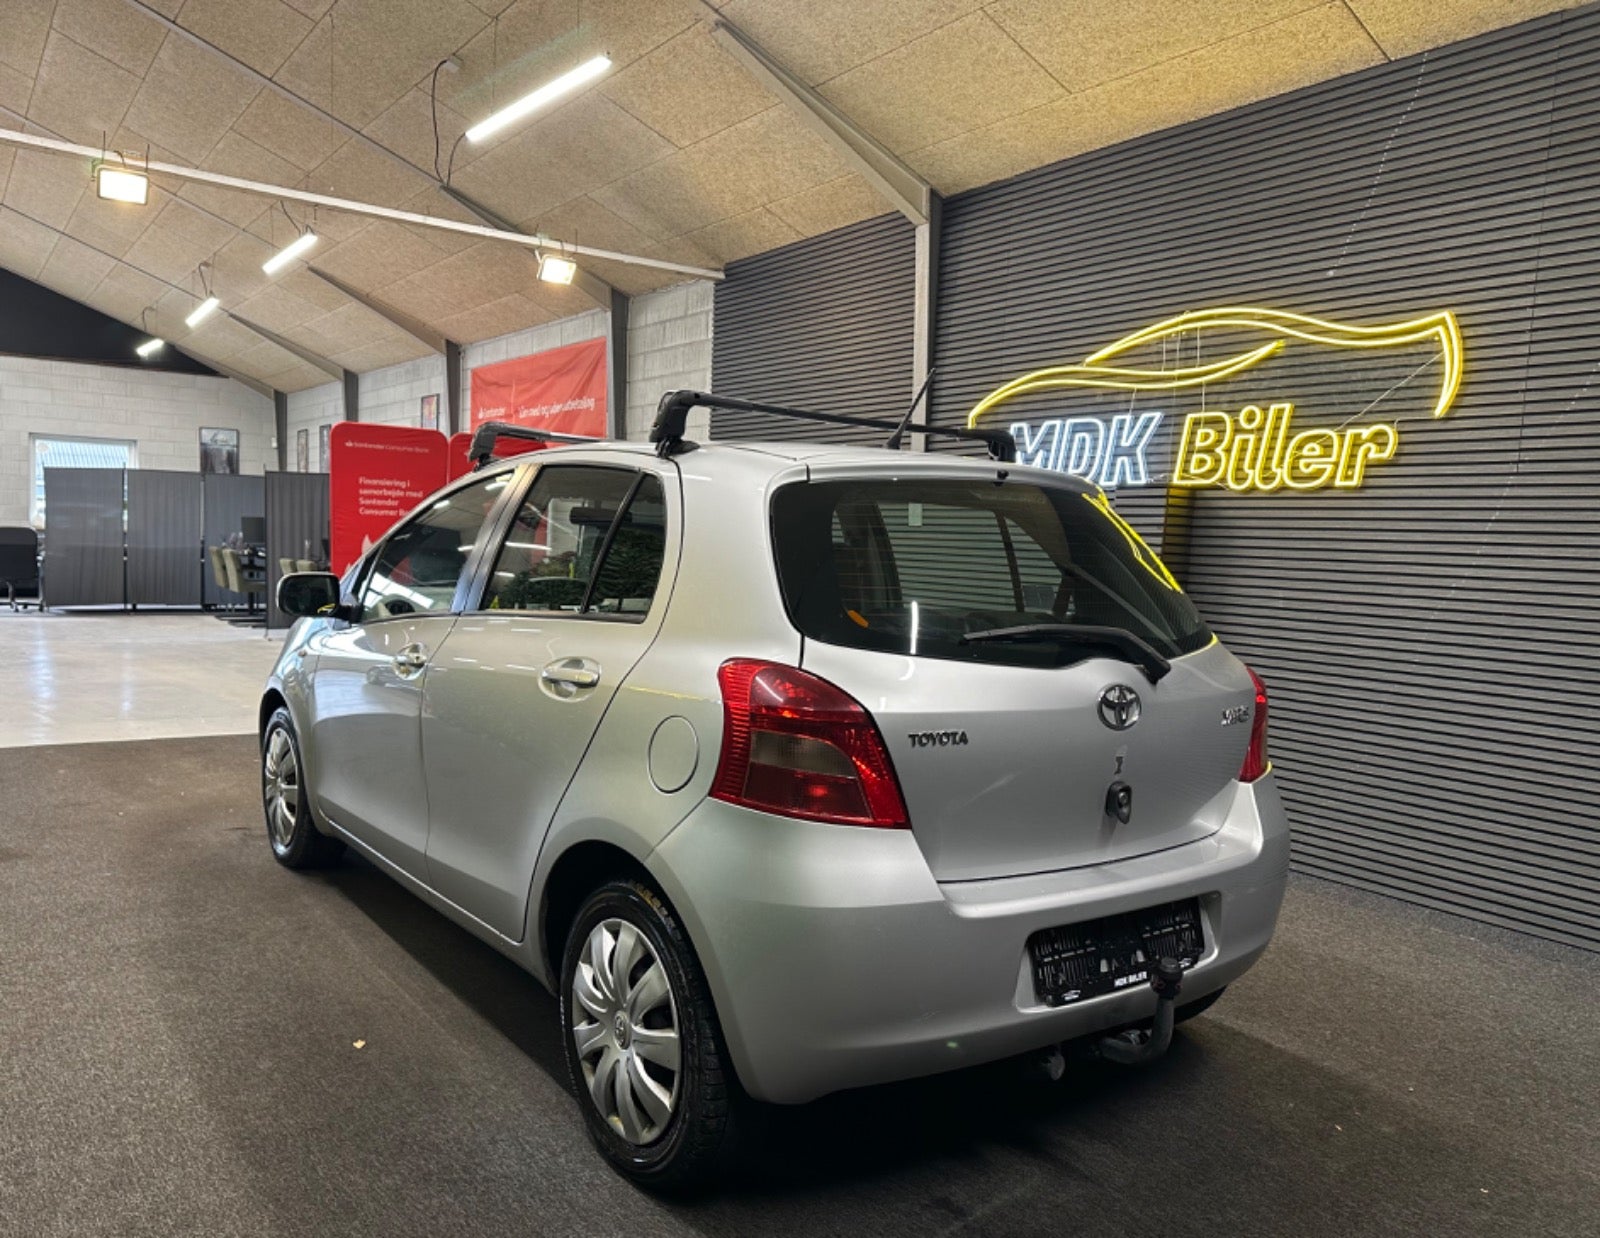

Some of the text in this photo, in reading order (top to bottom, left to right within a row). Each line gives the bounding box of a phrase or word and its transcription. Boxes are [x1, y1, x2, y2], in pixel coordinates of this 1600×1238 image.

[1010, 402, 1399, 492] MDK Biler
[359, 477, 406, 488] Finansiering
[405, 490, 423, 498] med
[359, 497, 398, 506] Santander
[359, 507, 398, 516] Consumer
[908, 731, 968, 748] TOYOTA
